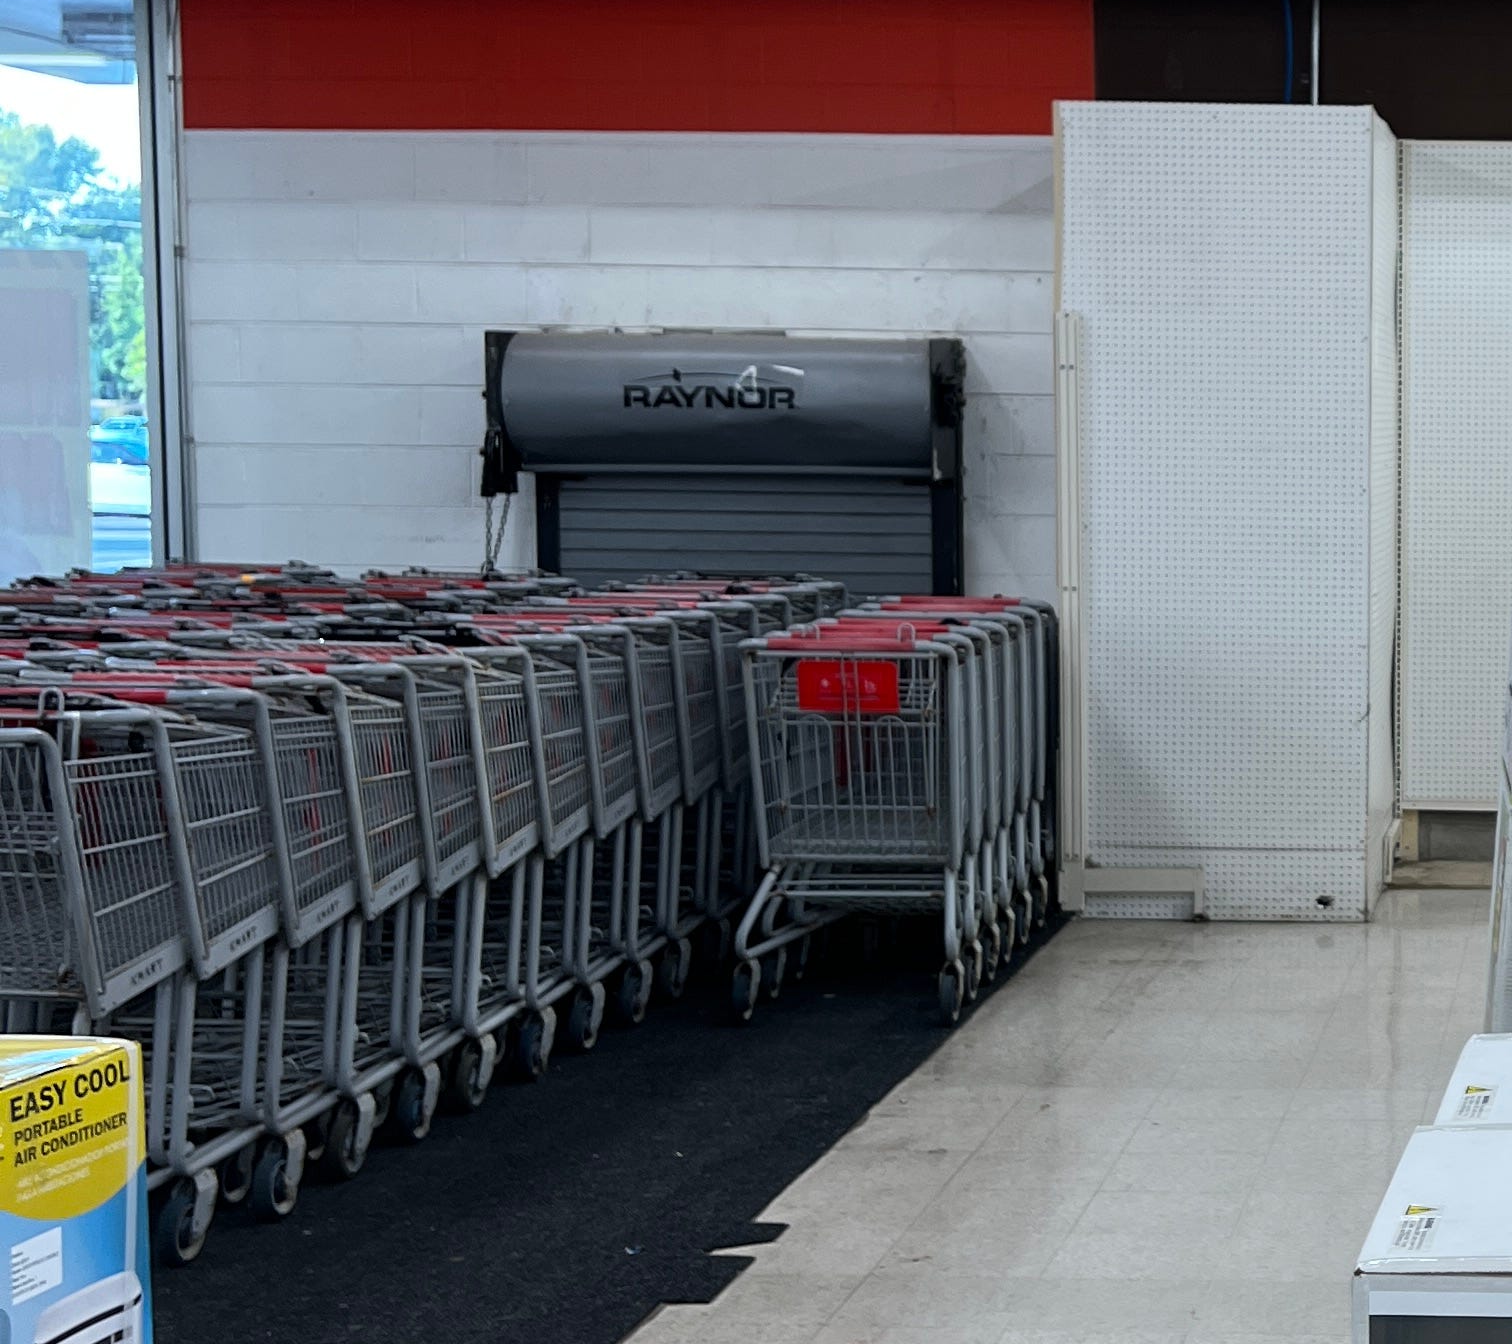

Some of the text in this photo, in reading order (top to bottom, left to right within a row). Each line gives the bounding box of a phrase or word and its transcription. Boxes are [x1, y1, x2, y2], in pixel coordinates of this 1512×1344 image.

[623, 385, 795, 410] RAYNOR
[10, 1060, 130, 1122] EASY COOL
[14, 1108, 83, 1146] PORTABLE
[14, 1146, 37, 1167] AIR
[41, 1112, 127, 1156] CONDITIONER
